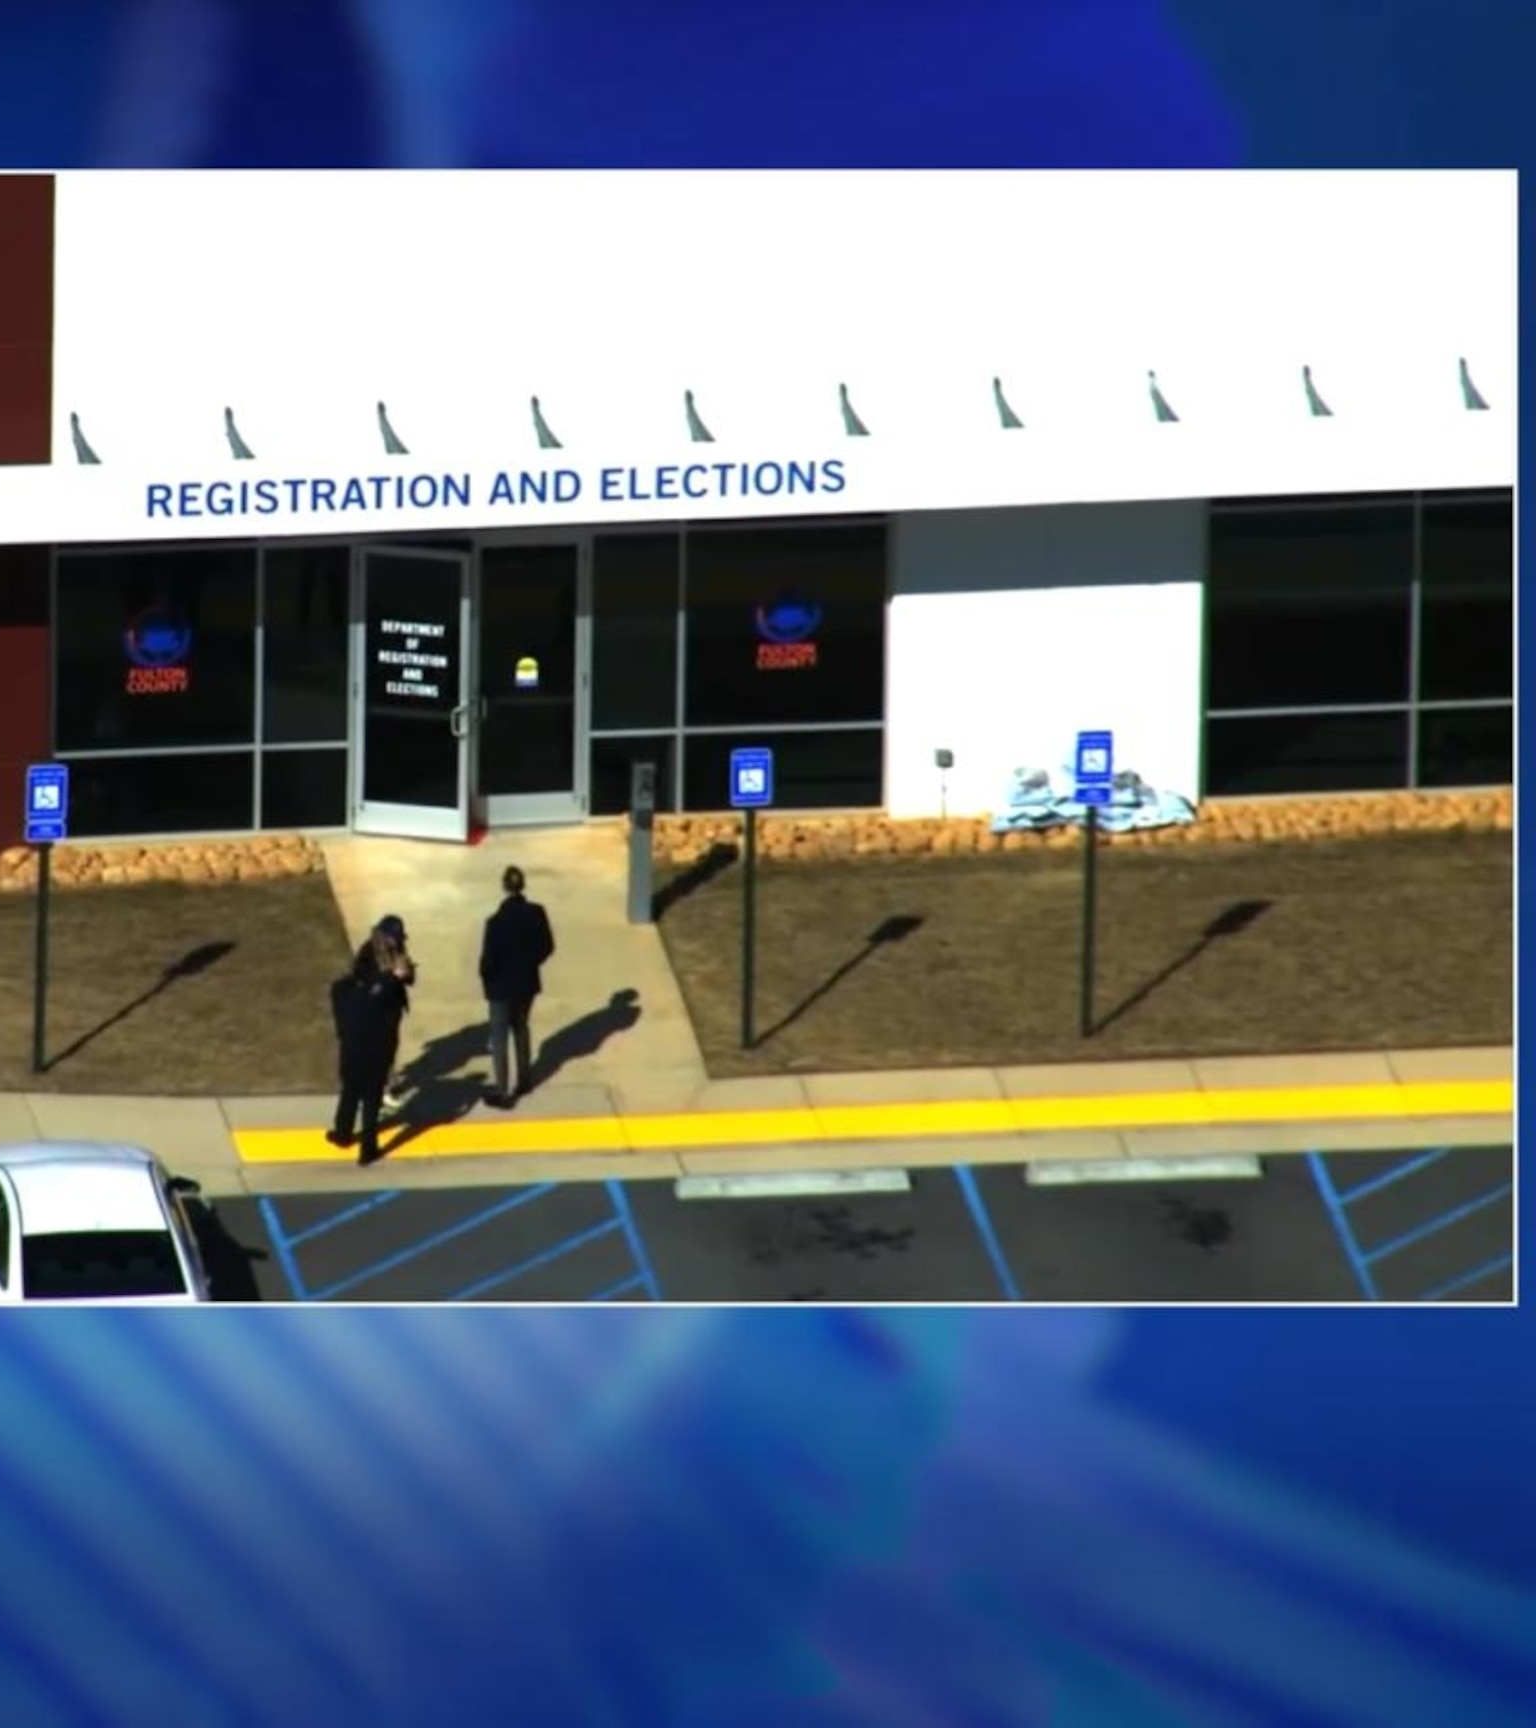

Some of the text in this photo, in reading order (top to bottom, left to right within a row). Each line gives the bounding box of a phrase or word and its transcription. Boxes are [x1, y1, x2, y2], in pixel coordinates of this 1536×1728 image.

[146, 460, 846, 518] REGISTRATION AND ELECTIONS
[381, 620, 445, 636] DEPARTMENT
[406, 637, 419, 650] OF
[378, 649, 448, 668] REGISTRATION
[129, 668, 186, 681] FULTON
[402, 668, 423, 681] AND
[126, 679, 188, 693] COUNTY
[386, 681, 439, 697] ELECTIONS
